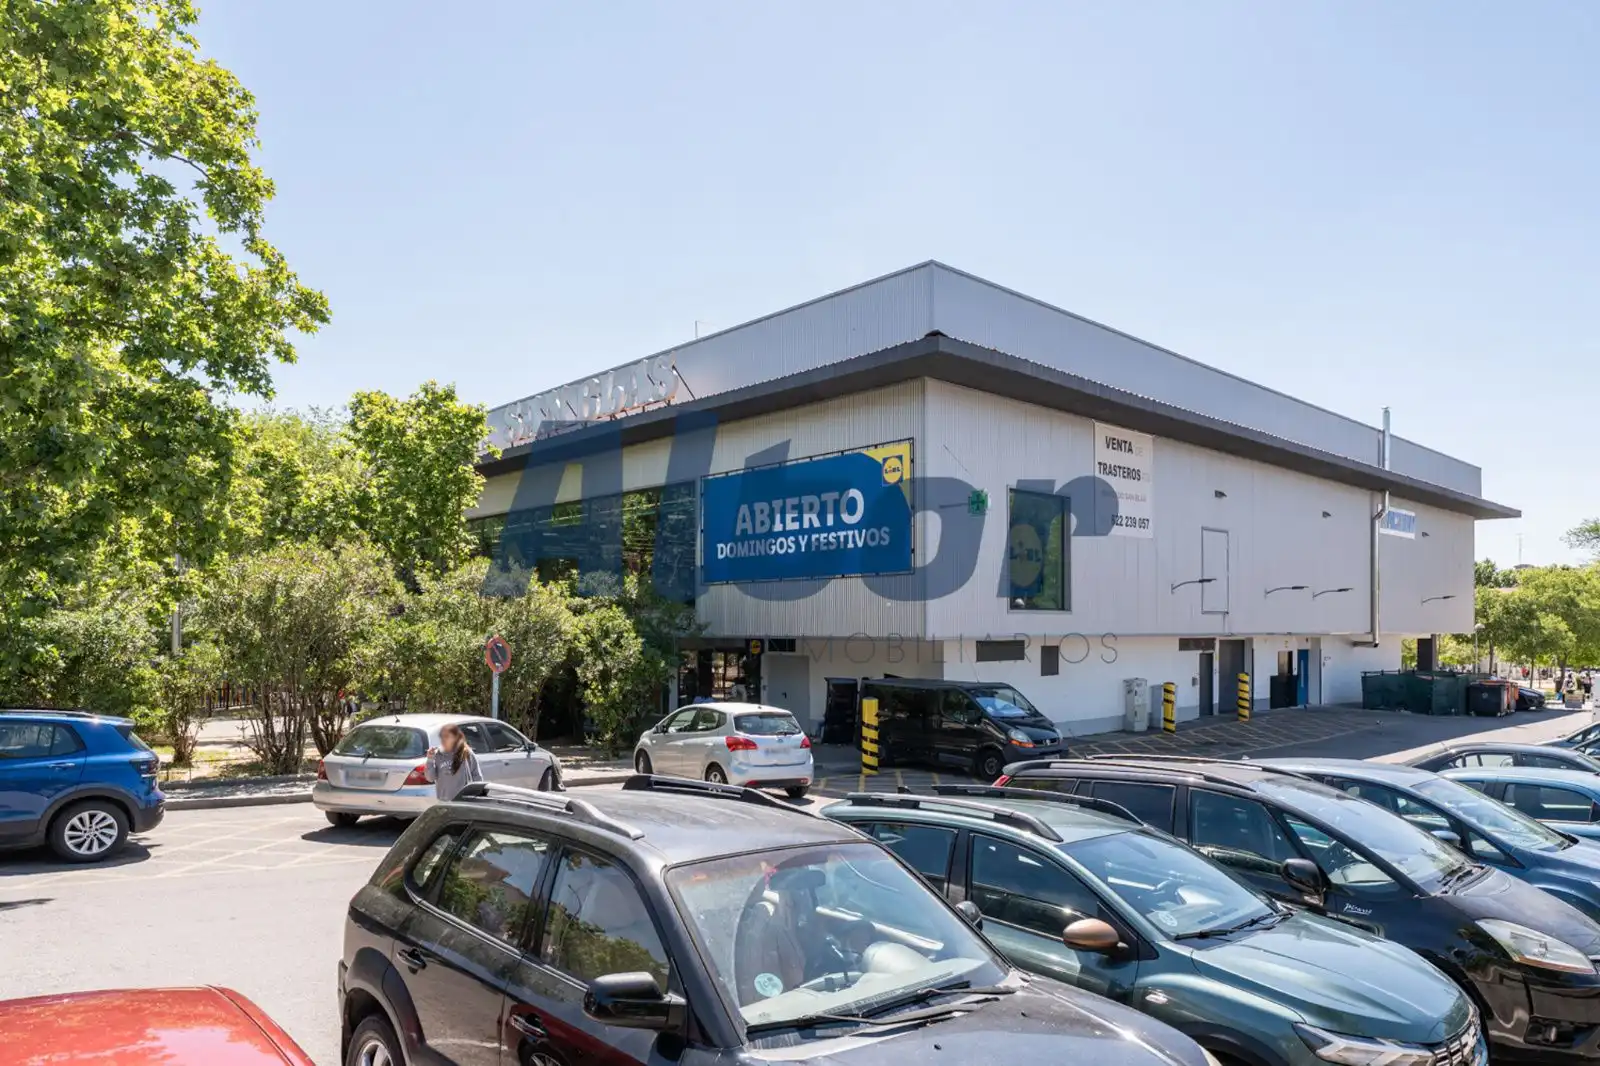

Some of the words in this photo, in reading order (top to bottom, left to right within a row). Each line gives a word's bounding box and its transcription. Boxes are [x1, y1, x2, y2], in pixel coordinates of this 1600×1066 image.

[1105, 435, 1133, 454] VENTA
[1097, 461, 1142, 481] TRASTEROS
[735, 488, 865, 536] ABIERTO
[1124, 516, 1137, 529] 239
[1137, 517, 1150, 531] 057
[716, 535, 796, 560] DOMINGOS
[799, 534, 809, 552] Y
[811, 526, 891, 552] FESTIVOS
